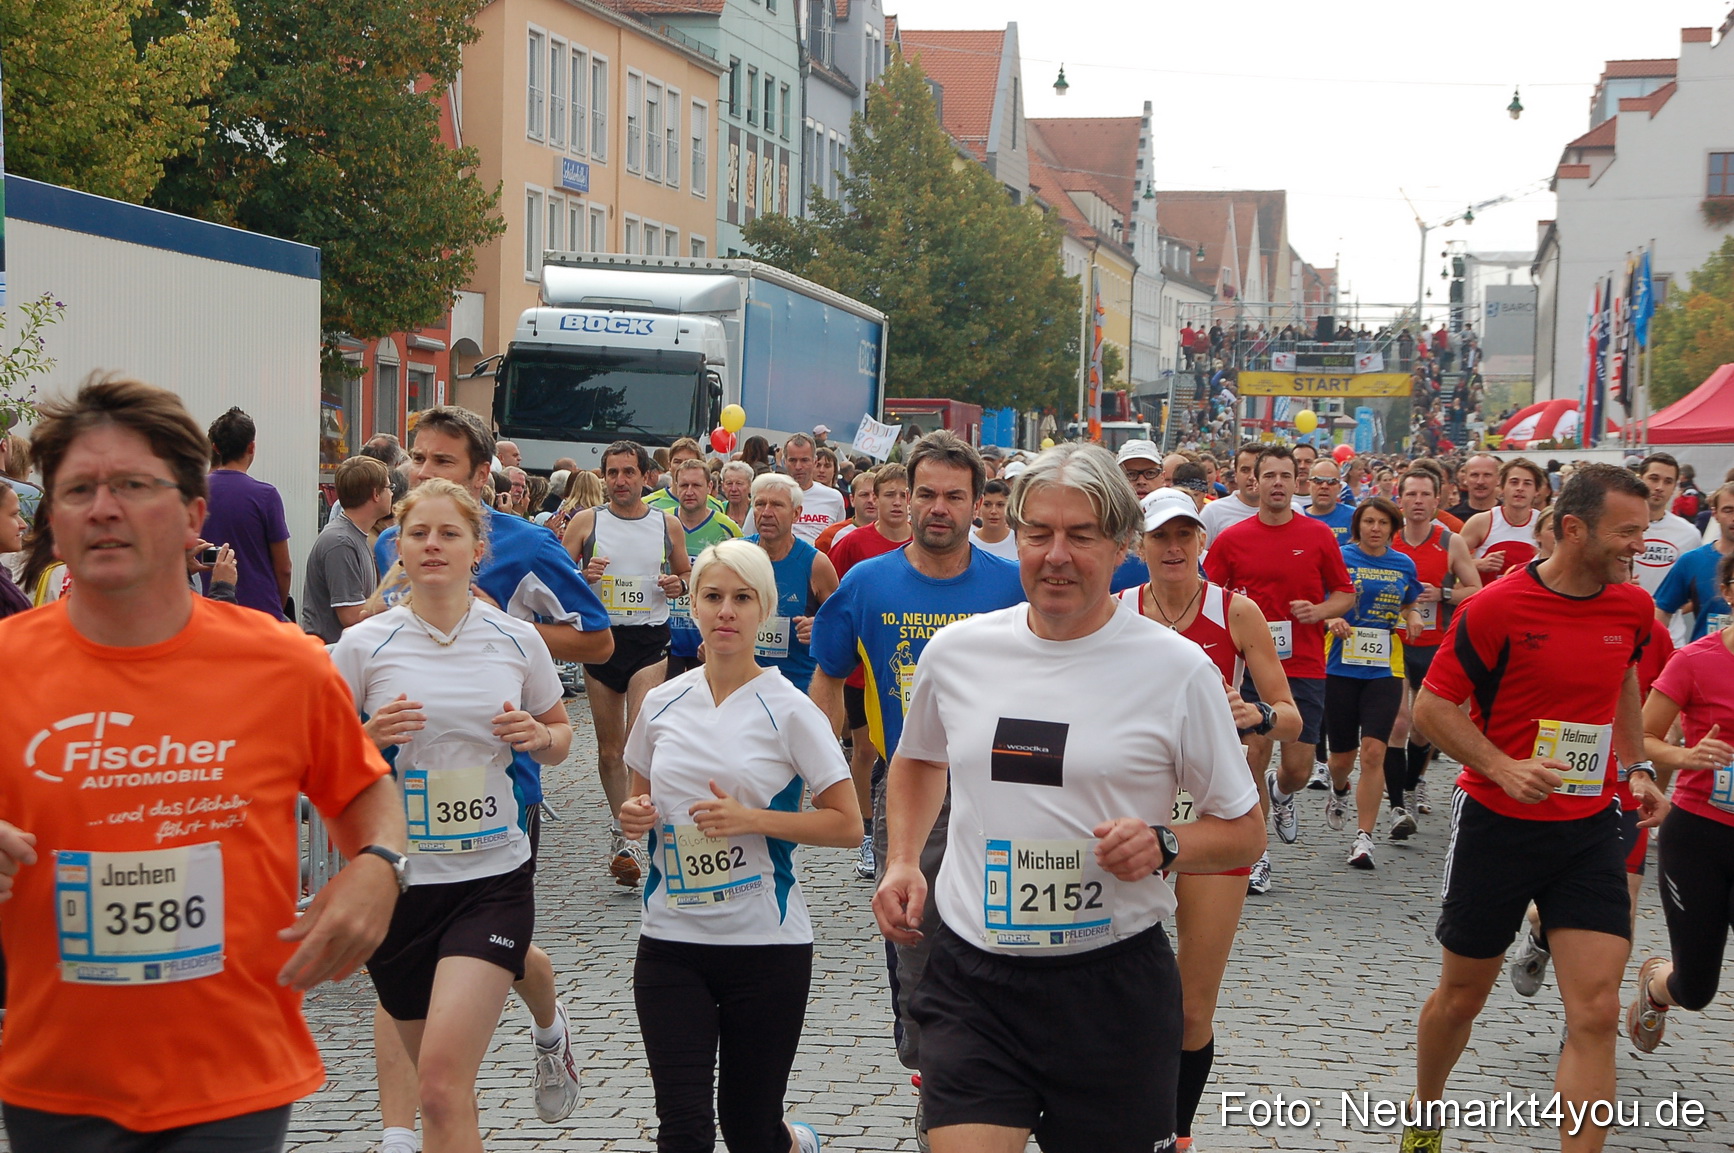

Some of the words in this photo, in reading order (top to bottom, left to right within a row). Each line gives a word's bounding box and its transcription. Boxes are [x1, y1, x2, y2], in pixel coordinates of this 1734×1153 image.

[560, 314, 655, 335] BOCK
[1293, 377, 1352, 392] START
[615, 578, 633, 587] Klaus
[620, 591, 644, 603] 159
[881, 612, 899, 625] 10.
[1361, 643, 1383, 654] 452
[1561, 728, 1598, 745] Helmut
[62, 735, 237, 772] Fischer
[1006, 744, 1049, 753] woodka
[1565, 751, 1599, 772] 380
[80, 767, 225, 790] AUTOMOBILE
[107, 804, 145, 825] und
[149, 800, 184, 816] das
[436, 796, 498, 824] 3863
[685, 845, 747, 877] 3862
[1018, 849, 1080, 870] Michael
[101, 862, 176, 886] Jochen
[990, 880, 997, 895] D
[1020, 881, 1103, 912] 2152
[67, 899, 76, 916] D
[105, 895, 206, 935] 3586
[489, 933, 515, 949] JAKO
[1065, 924, 1110, 940] PFLEIDERER
[1154, 1132, 1178, 1153] FILA
